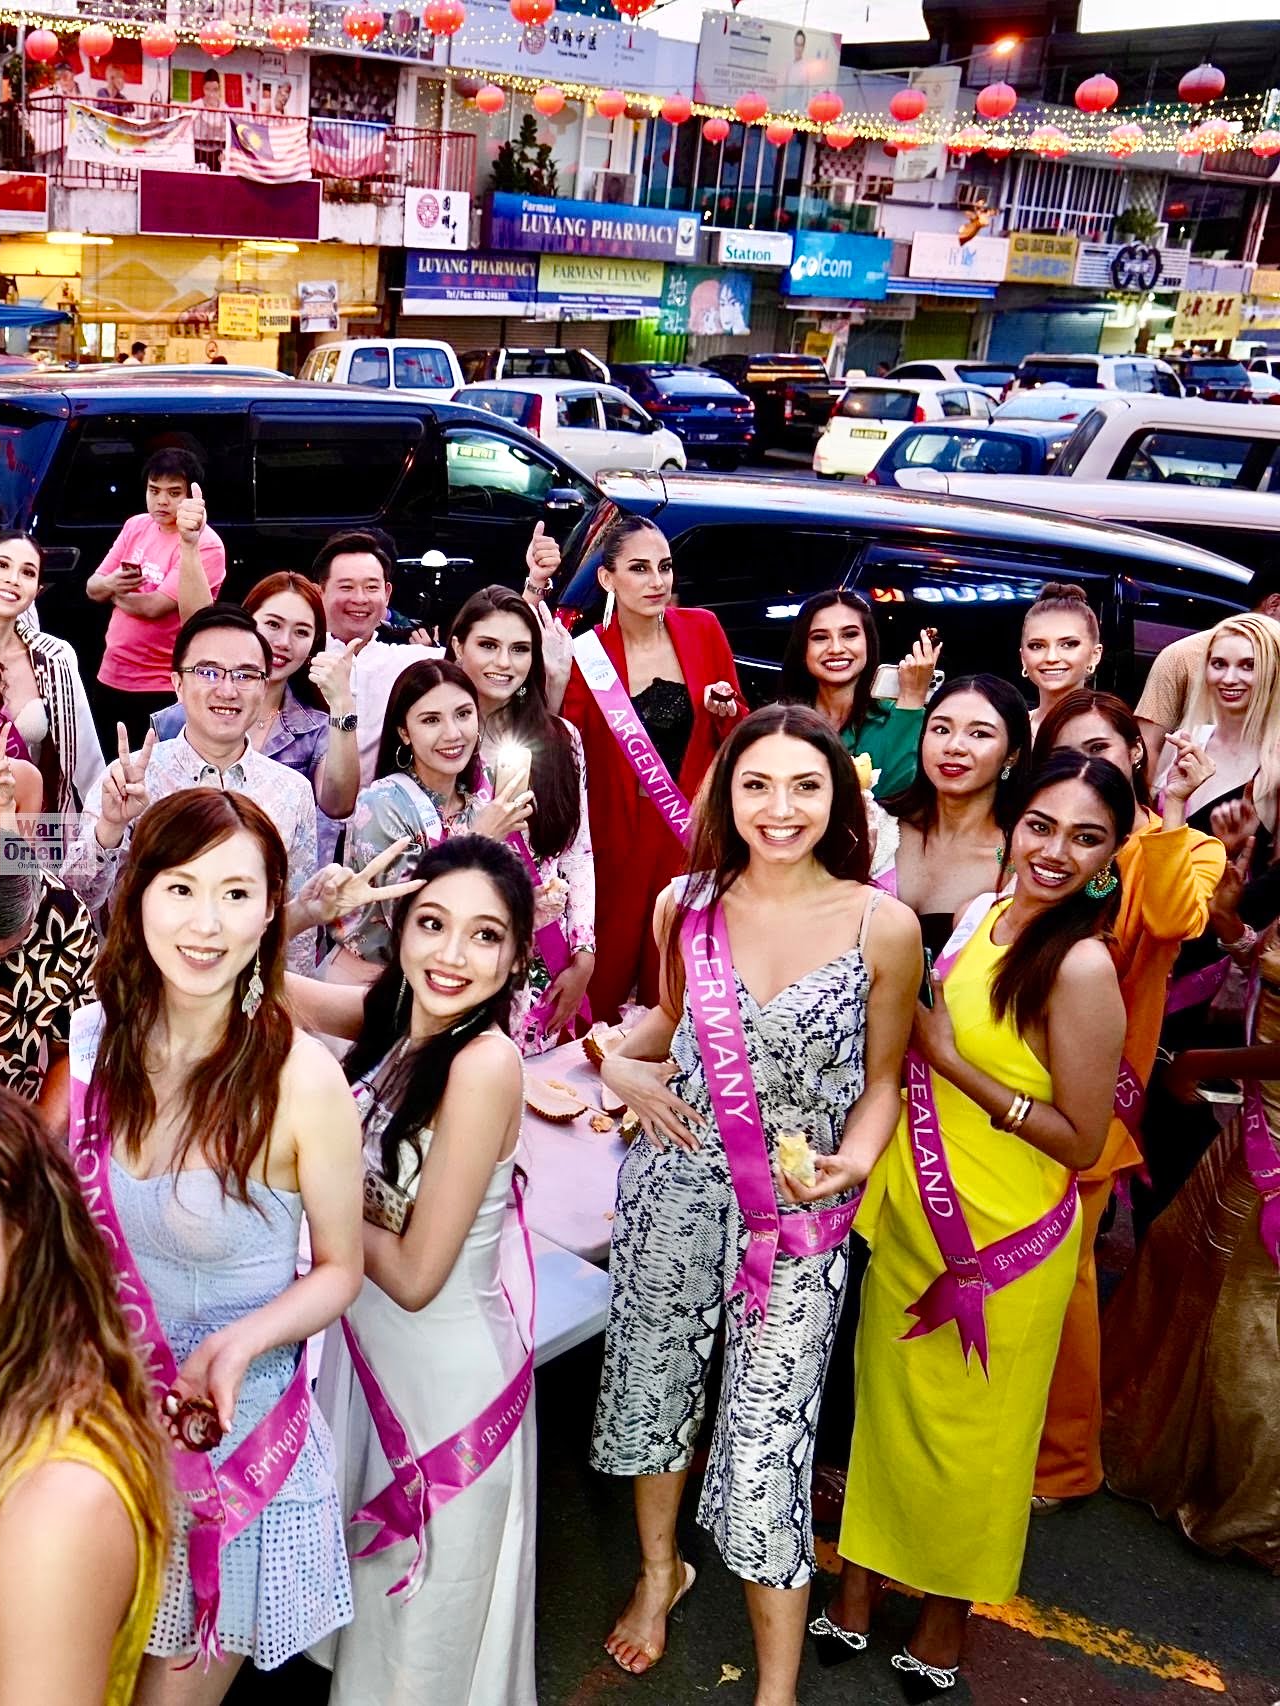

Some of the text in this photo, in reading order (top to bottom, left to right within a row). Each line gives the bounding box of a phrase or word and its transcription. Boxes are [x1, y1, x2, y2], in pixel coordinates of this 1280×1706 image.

[522, 200, 557, 213] Farmasi
[521, 213, 587, 237] LUYANG
[591, 220, 678, 245] PHARMACY
[418, 257, 536, 279] LUYANG PHARMACY
[552, 263, 652, 284] FARMASI LUYANG
[725, 245, 771, 262] Station
[607, 708, 694, 834] ARGENTINA
[691, 932, 755, 1126] GERMANY
[910, 1062, 955, 1219] ZEALAND
[993, 1219, 1062, 1271] Bringing
[243, 1397, 310, 1488] Bringing
